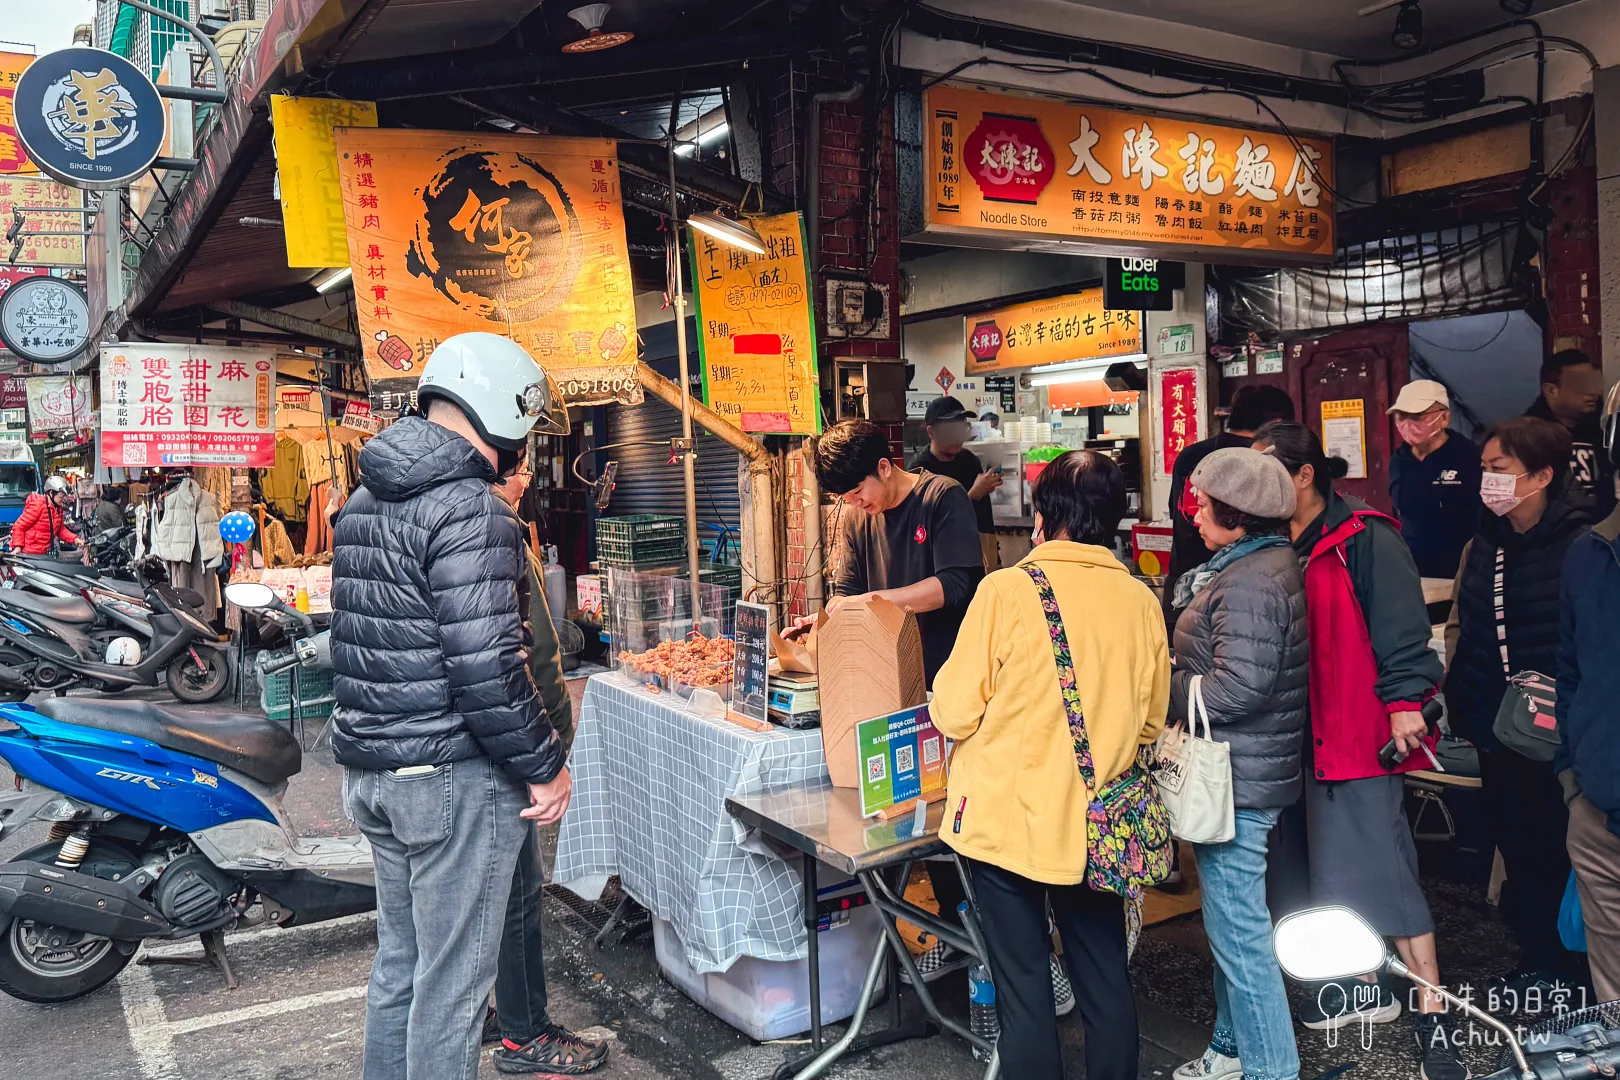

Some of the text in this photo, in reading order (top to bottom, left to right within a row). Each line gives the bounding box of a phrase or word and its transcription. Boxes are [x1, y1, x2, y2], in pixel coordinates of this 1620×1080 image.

[69, 163, 112, 173] SINCE 1999
[980, 139, 1042, 172] 大陳記
[1066, 114, 1322, 207] 大陳記麵店
[353, 151, 381, 230] 精選豬肉
[590, 159, 613, 230] 遵循古法
[1071, 188, 1140, 207] 南投意麵
[1155, 196, 1203, 213] 陽春麵
[1278, 209, 1319, 224] 米苔目
[46, 220, 71, 232] 700
[448, 188, 534, 278] 何家
[980, 210, 1048, 227] Noodle Store
[1071, 207, 1320, 240] 香菇肉粥 魯肉飯 紅燒肉 炸豆腐
[703, 235, 723, 282] 早上
[1121, 256, 1159, 272] Uber
[1121, 272, 1159, 291] Eats
[21, 336, 75, 348] 豪華小吃部
[972, 333, 1000, 349] 大陳記
[1005, 309, 1136, 348] 台灣幸福的古早味
[1098, 338, 1136, 349] Since 1989
[1174, 339, 1186, 352] 18
[1265, 362, 1274, 371] 20
[117, 380, 128, 427] 博士雙胞胎
[139, 357, 174, 427] 雙胞胎
[179, 358, 212, 427] 甜甜圈
[217, 359, 250, 428] 麻花
[1171, 383, 1187, 452] 有大願力
[96, 767, 161, 790] GTR
